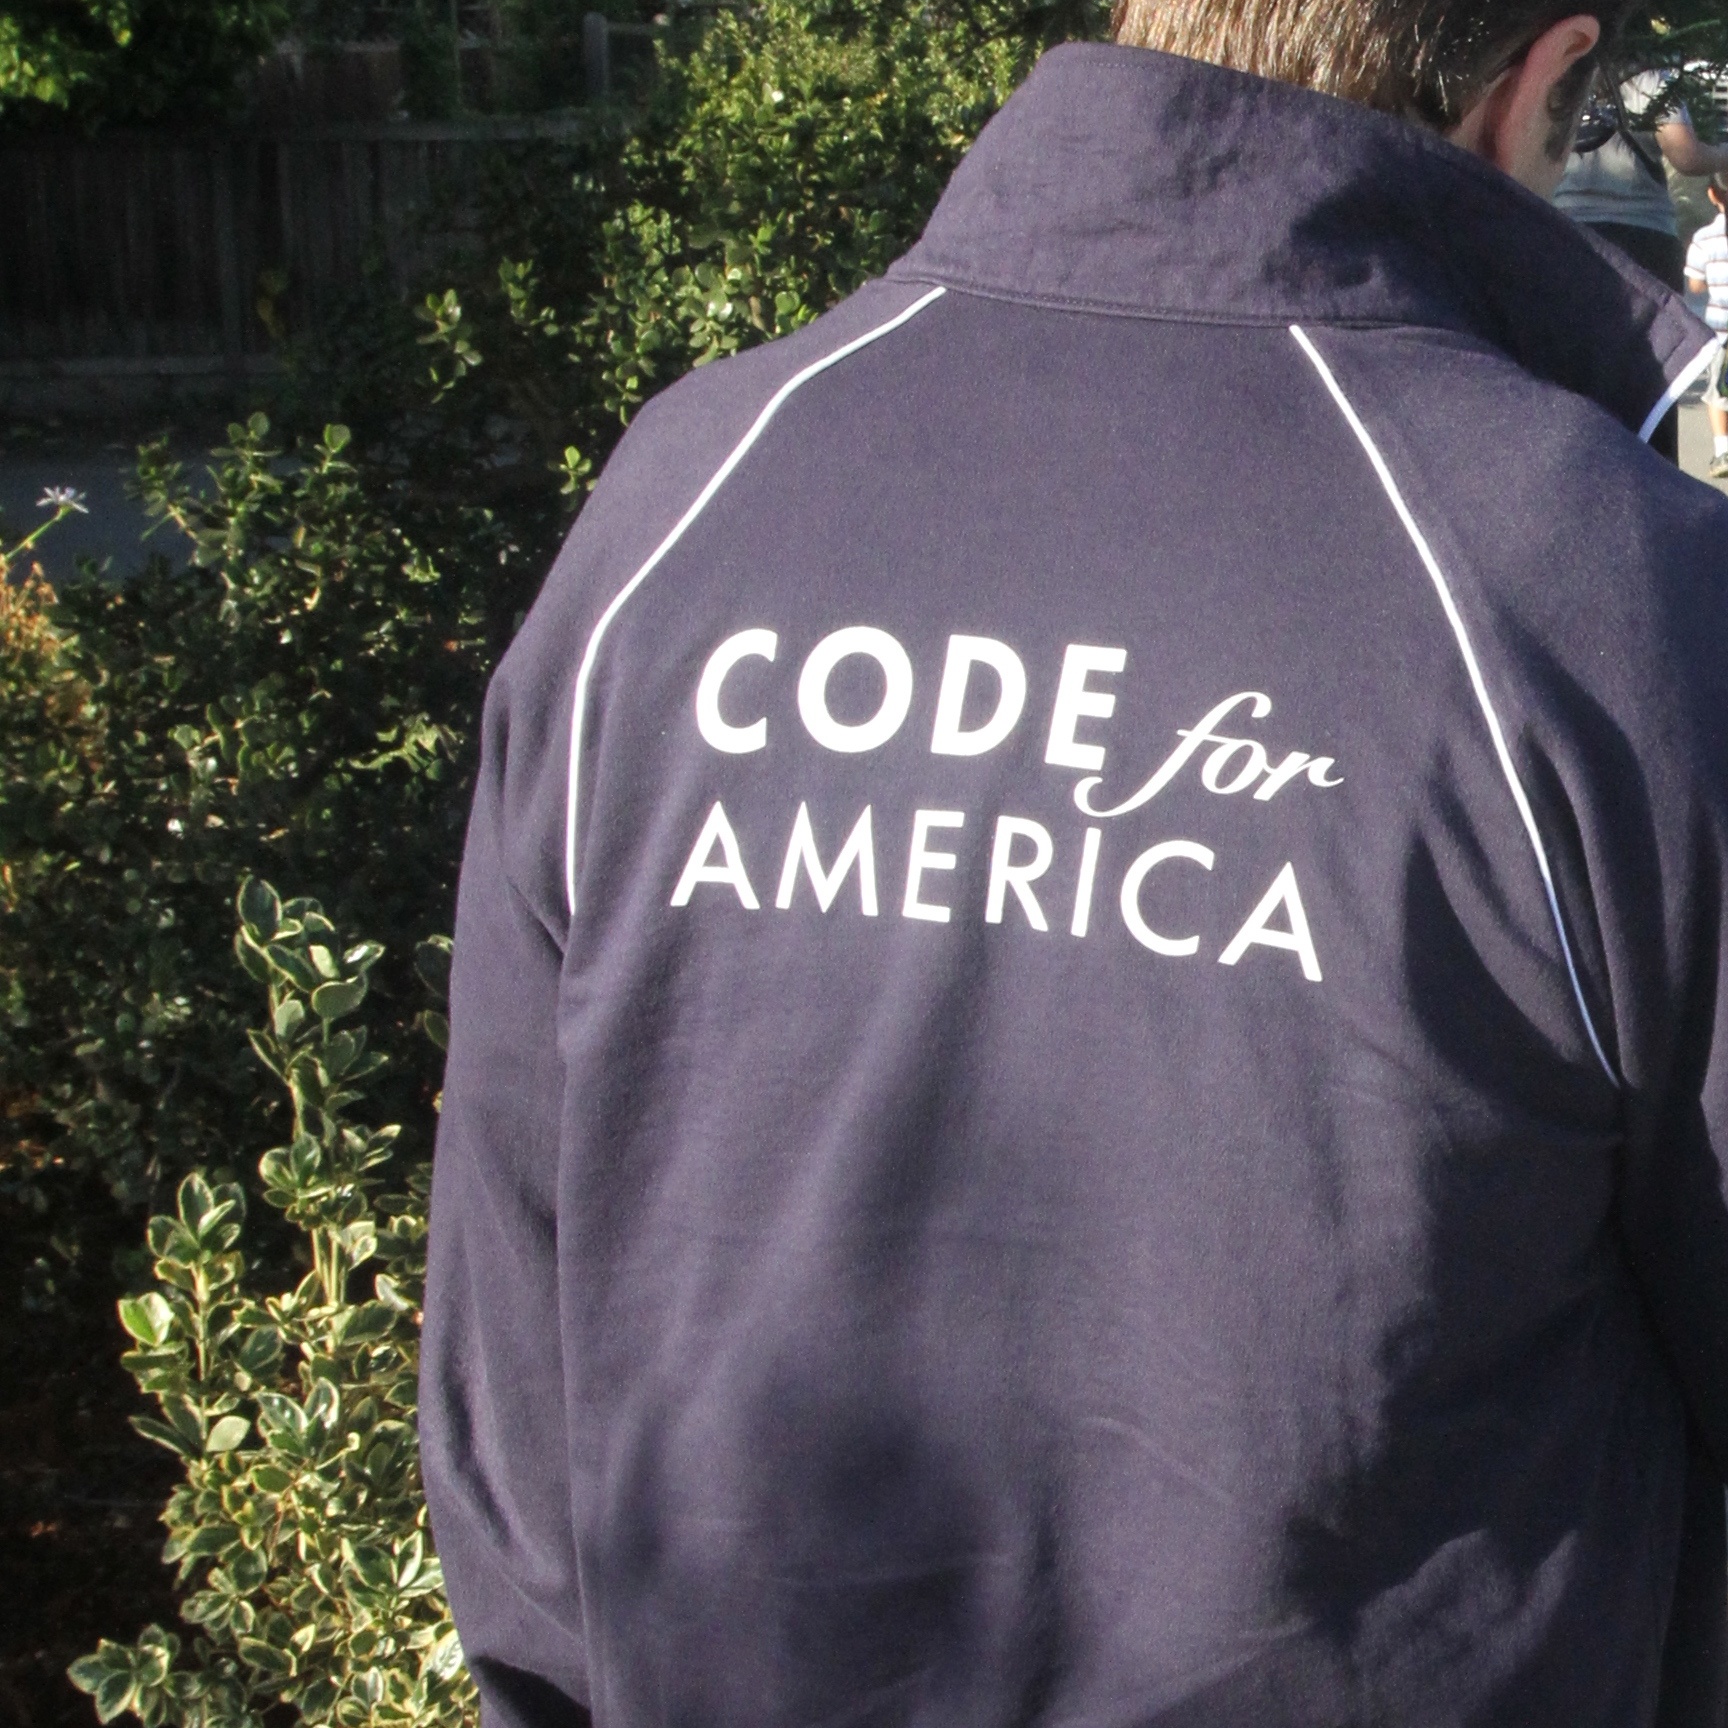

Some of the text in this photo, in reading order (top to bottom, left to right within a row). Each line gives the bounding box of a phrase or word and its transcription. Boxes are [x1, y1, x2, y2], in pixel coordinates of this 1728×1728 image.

[694, 624, 1345, 819] CODE for
[669, 799, 1324, 983] AMERICA
